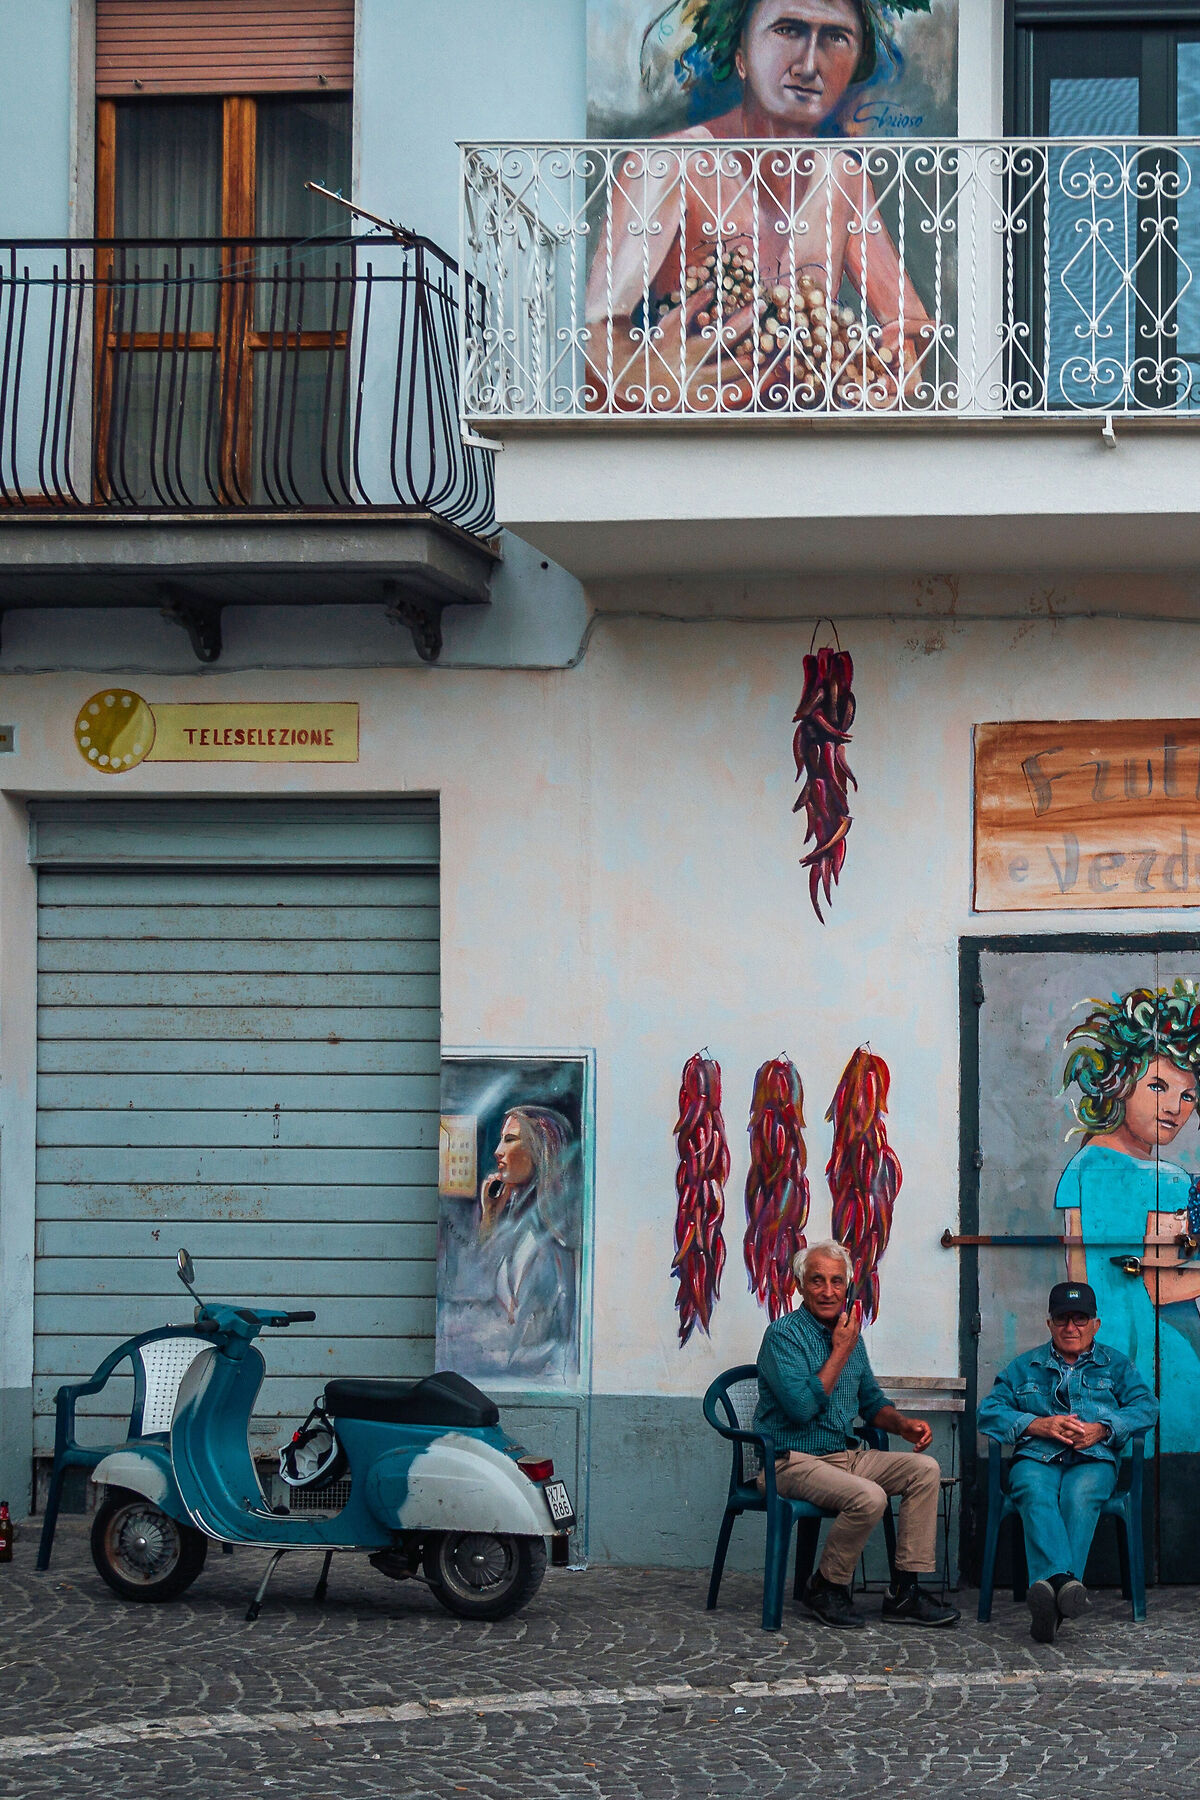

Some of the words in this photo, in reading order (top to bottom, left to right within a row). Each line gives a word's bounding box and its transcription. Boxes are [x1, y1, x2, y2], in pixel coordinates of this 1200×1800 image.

[182, 727, 335, 747] TELESELEZIONE
[1007, 853, 1030, 883] e
[553, 1501, 570, 1517] R86
